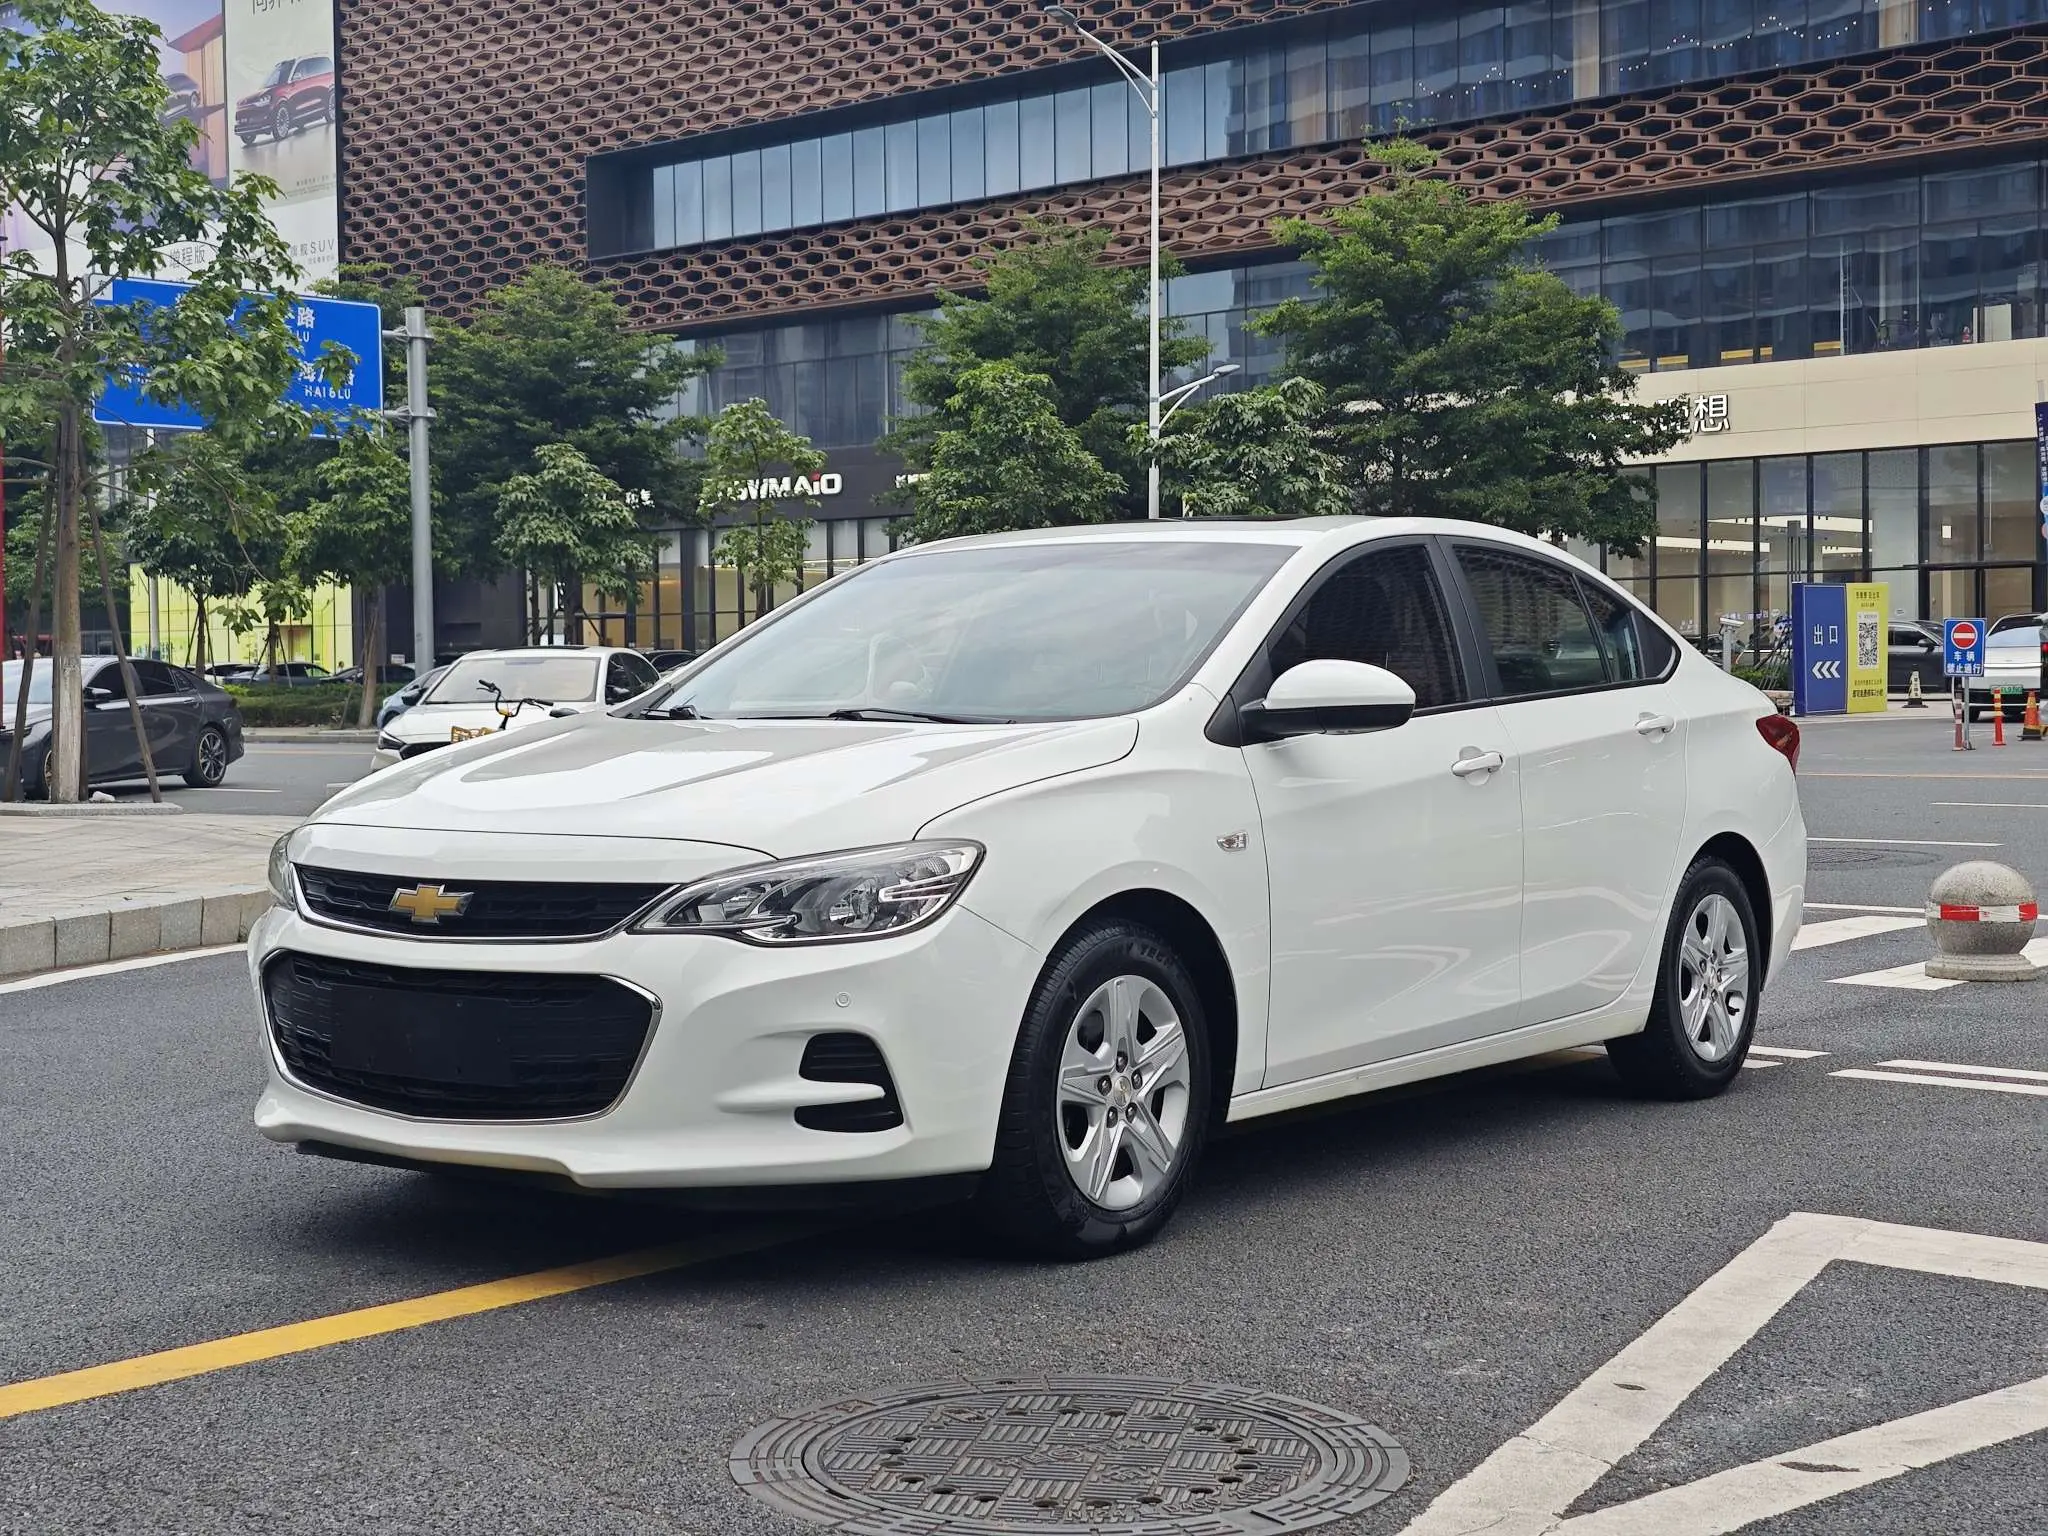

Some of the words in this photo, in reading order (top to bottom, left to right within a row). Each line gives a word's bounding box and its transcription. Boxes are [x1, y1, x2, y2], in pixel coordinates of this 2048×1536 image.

[1813, 623, 1839, 646] 出口
[1953, 650, 1975, 662] 车辆
[1946, 662, 1981, 674] 禁止通行
